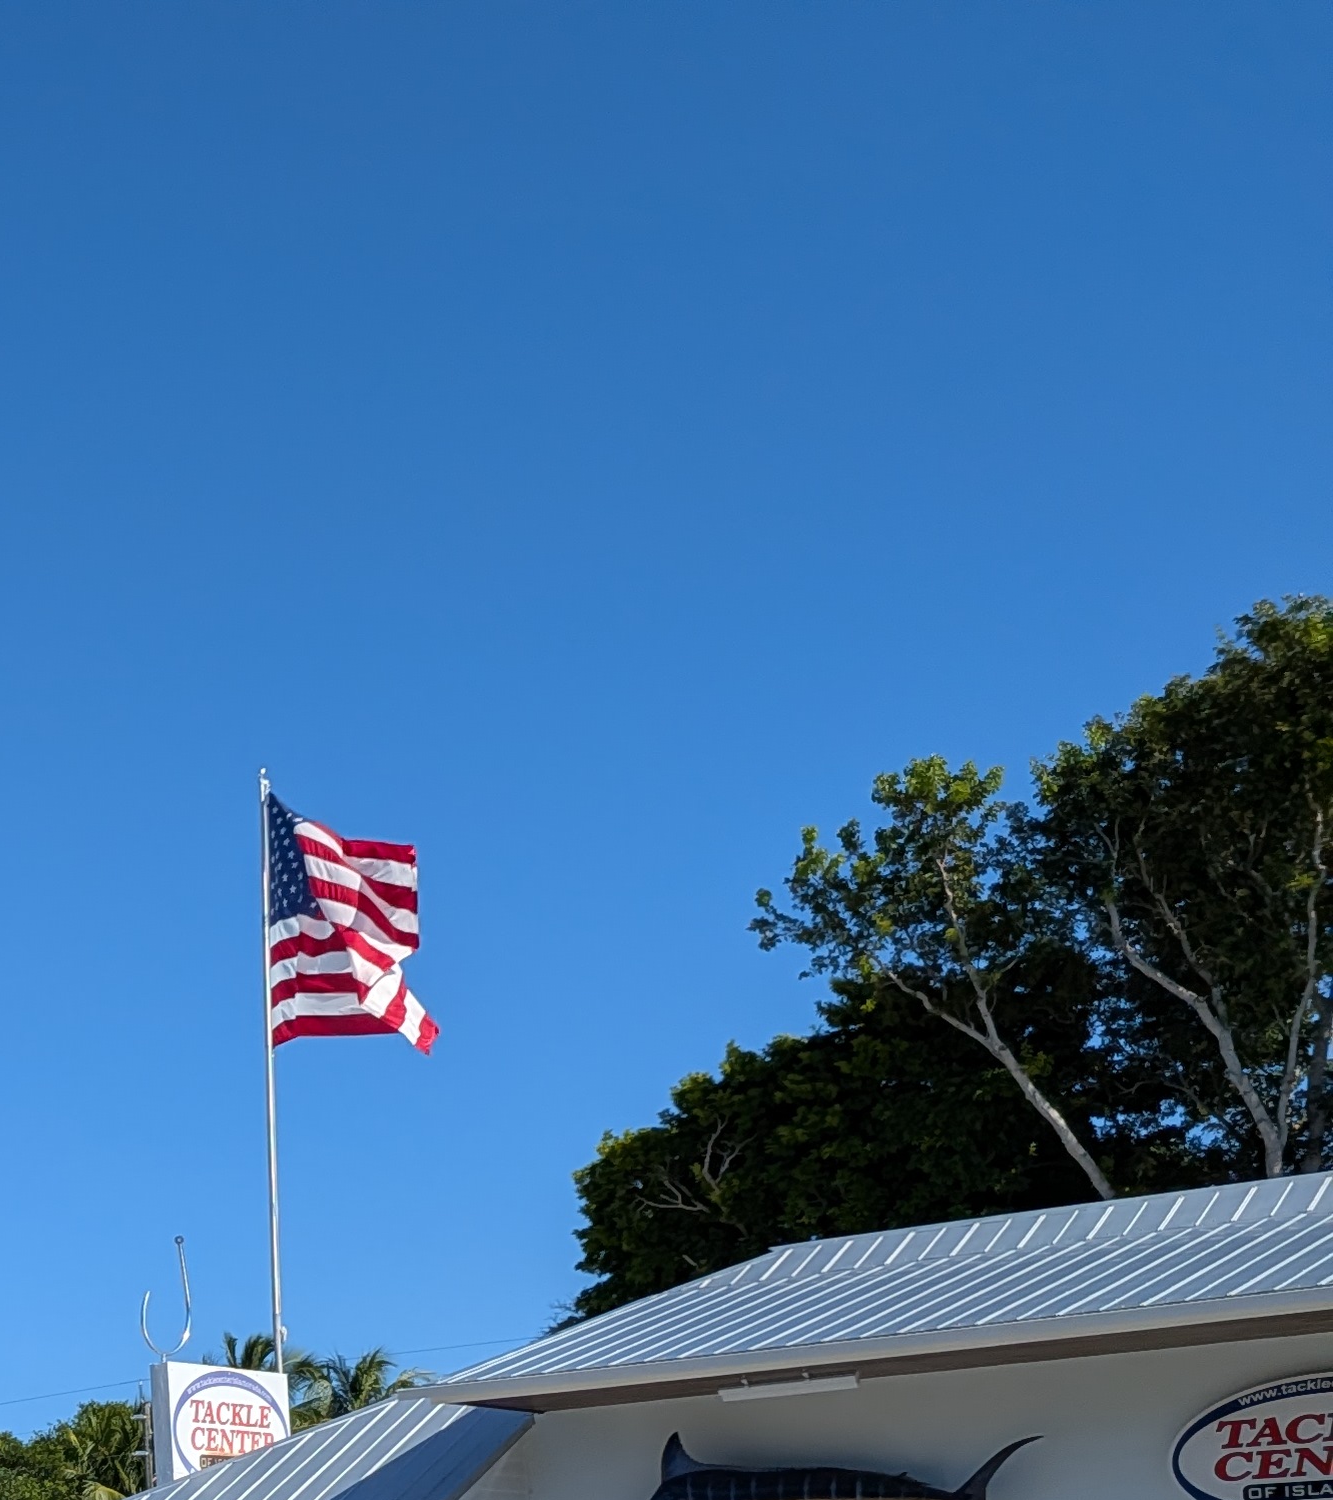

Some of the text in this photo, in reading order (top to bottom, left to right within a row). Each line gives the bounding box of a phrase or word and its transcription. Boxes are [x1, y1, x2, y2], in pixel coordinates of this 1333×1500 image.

[1237, 1379, 1333, 1406] www.tackle
[190, 1399, 271, 1428] TACKLE
[191, 1427, 274, 1453] CENTER
[1248, 1486, 1277, 1499] OF
